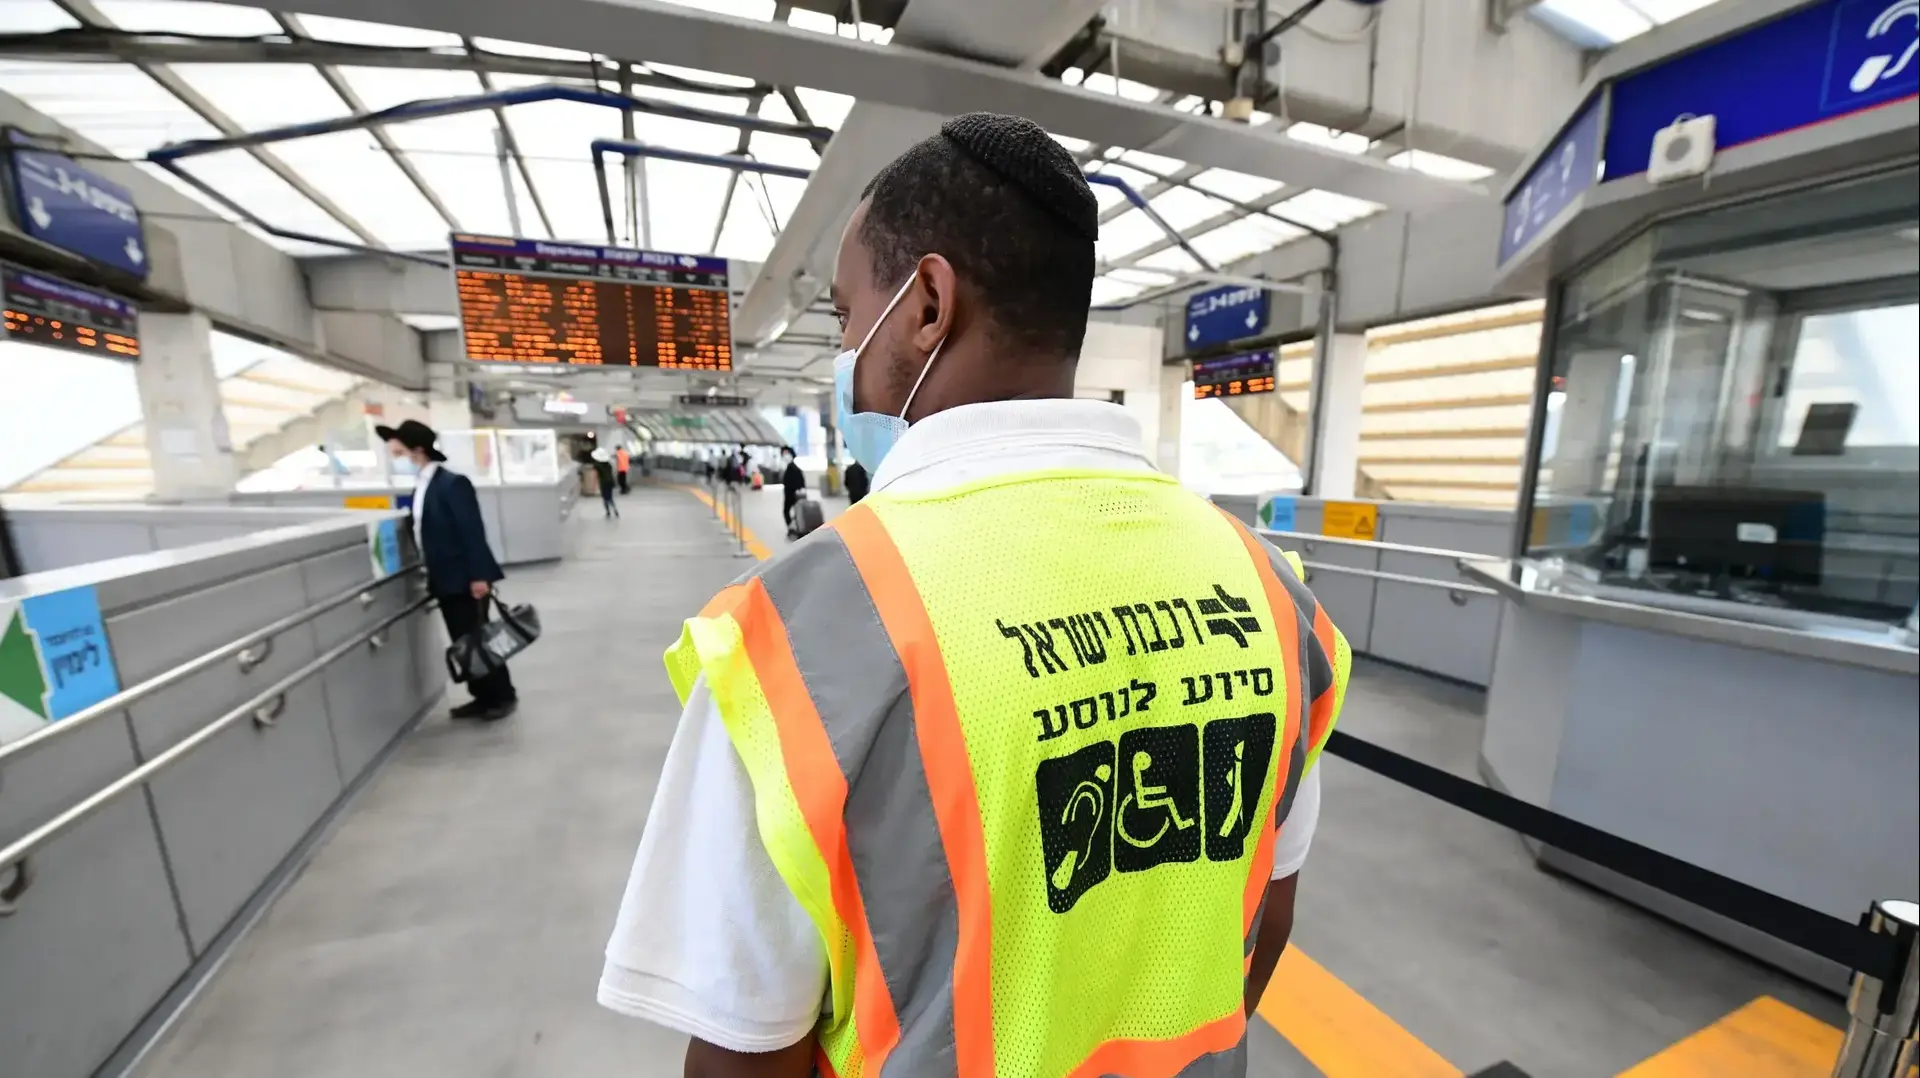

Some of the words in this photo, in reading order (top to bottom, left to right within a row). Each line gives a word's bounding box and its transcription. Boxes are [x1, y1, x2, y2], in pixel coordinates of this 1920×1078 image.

[995, 611, 1112, 678] ישראל
[1111, 598, 1204, 656] רכבת
[1033, 679, 1157, 742] לנוסע
[1181, 667, 1273, 706] סיוע
